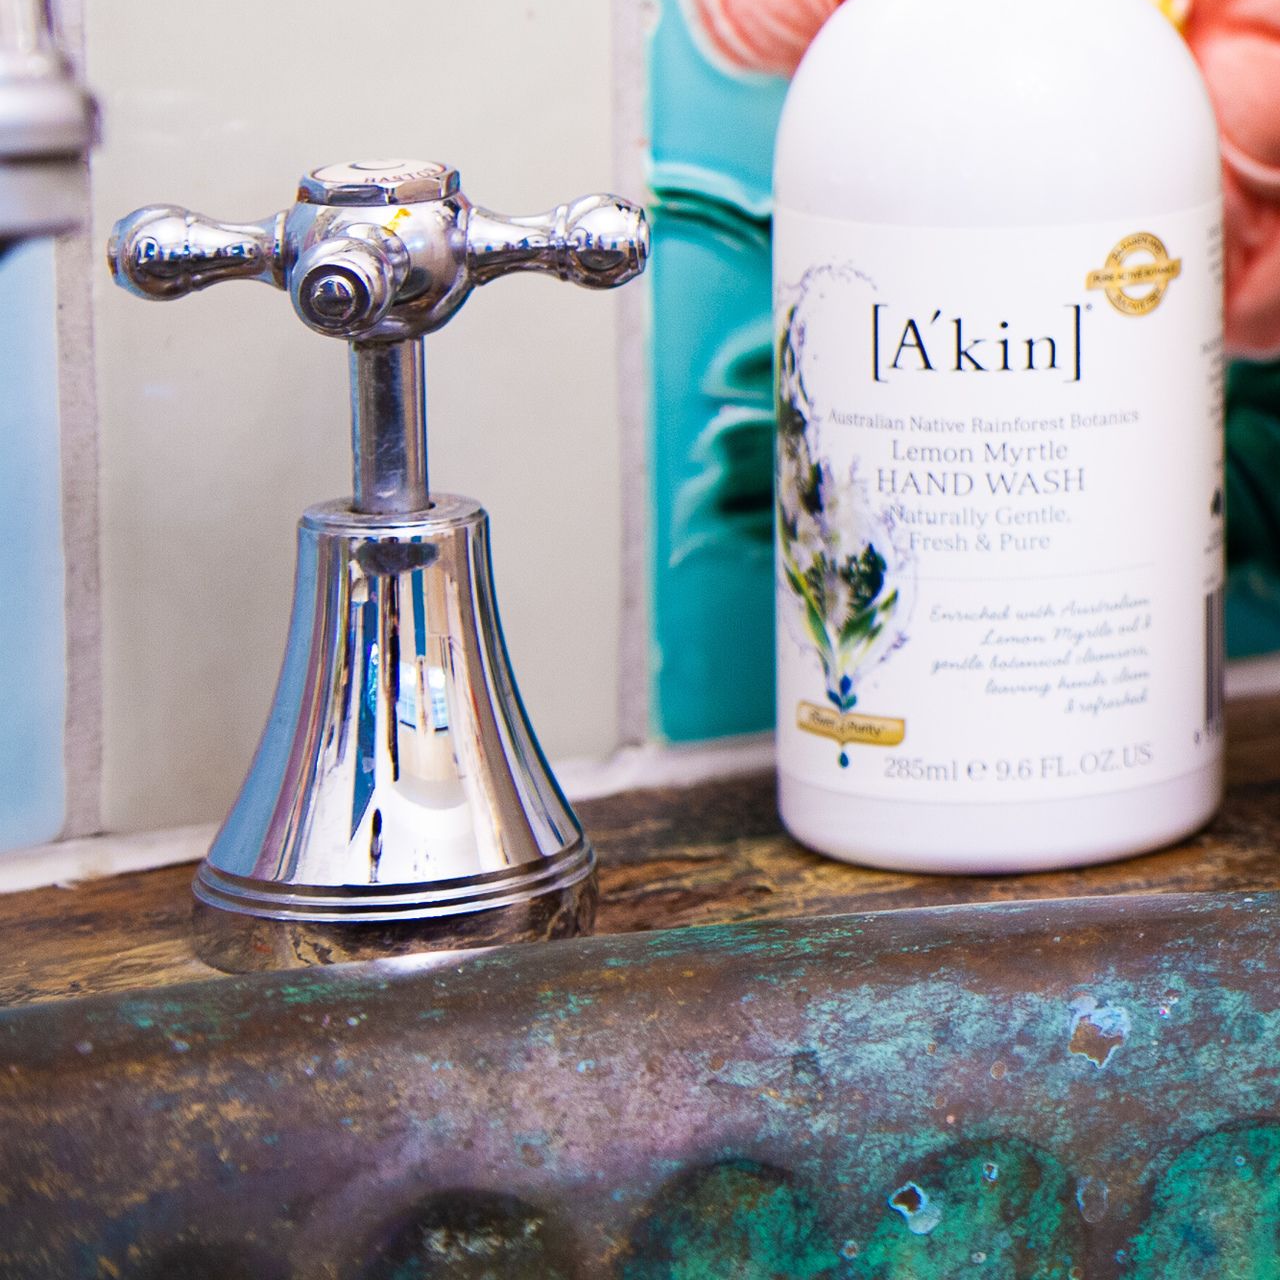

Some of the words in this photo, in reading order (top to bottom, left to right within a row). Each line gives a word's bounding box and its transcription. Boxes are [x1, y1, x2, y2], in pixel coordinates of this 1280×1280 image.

[828, 408, 905, 431] Australian
[909, 415, 965, 434] Native
[971, 414, 1065, 434] Rainforest
[1070, 408, 1141, 430] Botanics
[891, 439, 975, 463] Lemon
[983, 440, 1068, 470] Myrtle
[876, 468, 975, 497] HAND
[984, 467, 1086, 497] WASH
[889, 503, 989, 533] Naturally
[908, 532, 969, 553] Fresh
[974, 532, 992, 553] &
[999, 532, 1051, 552] Pure
[883, 754, 959, 782] 285ml
[994, 757, 1033, 782] 9.6
